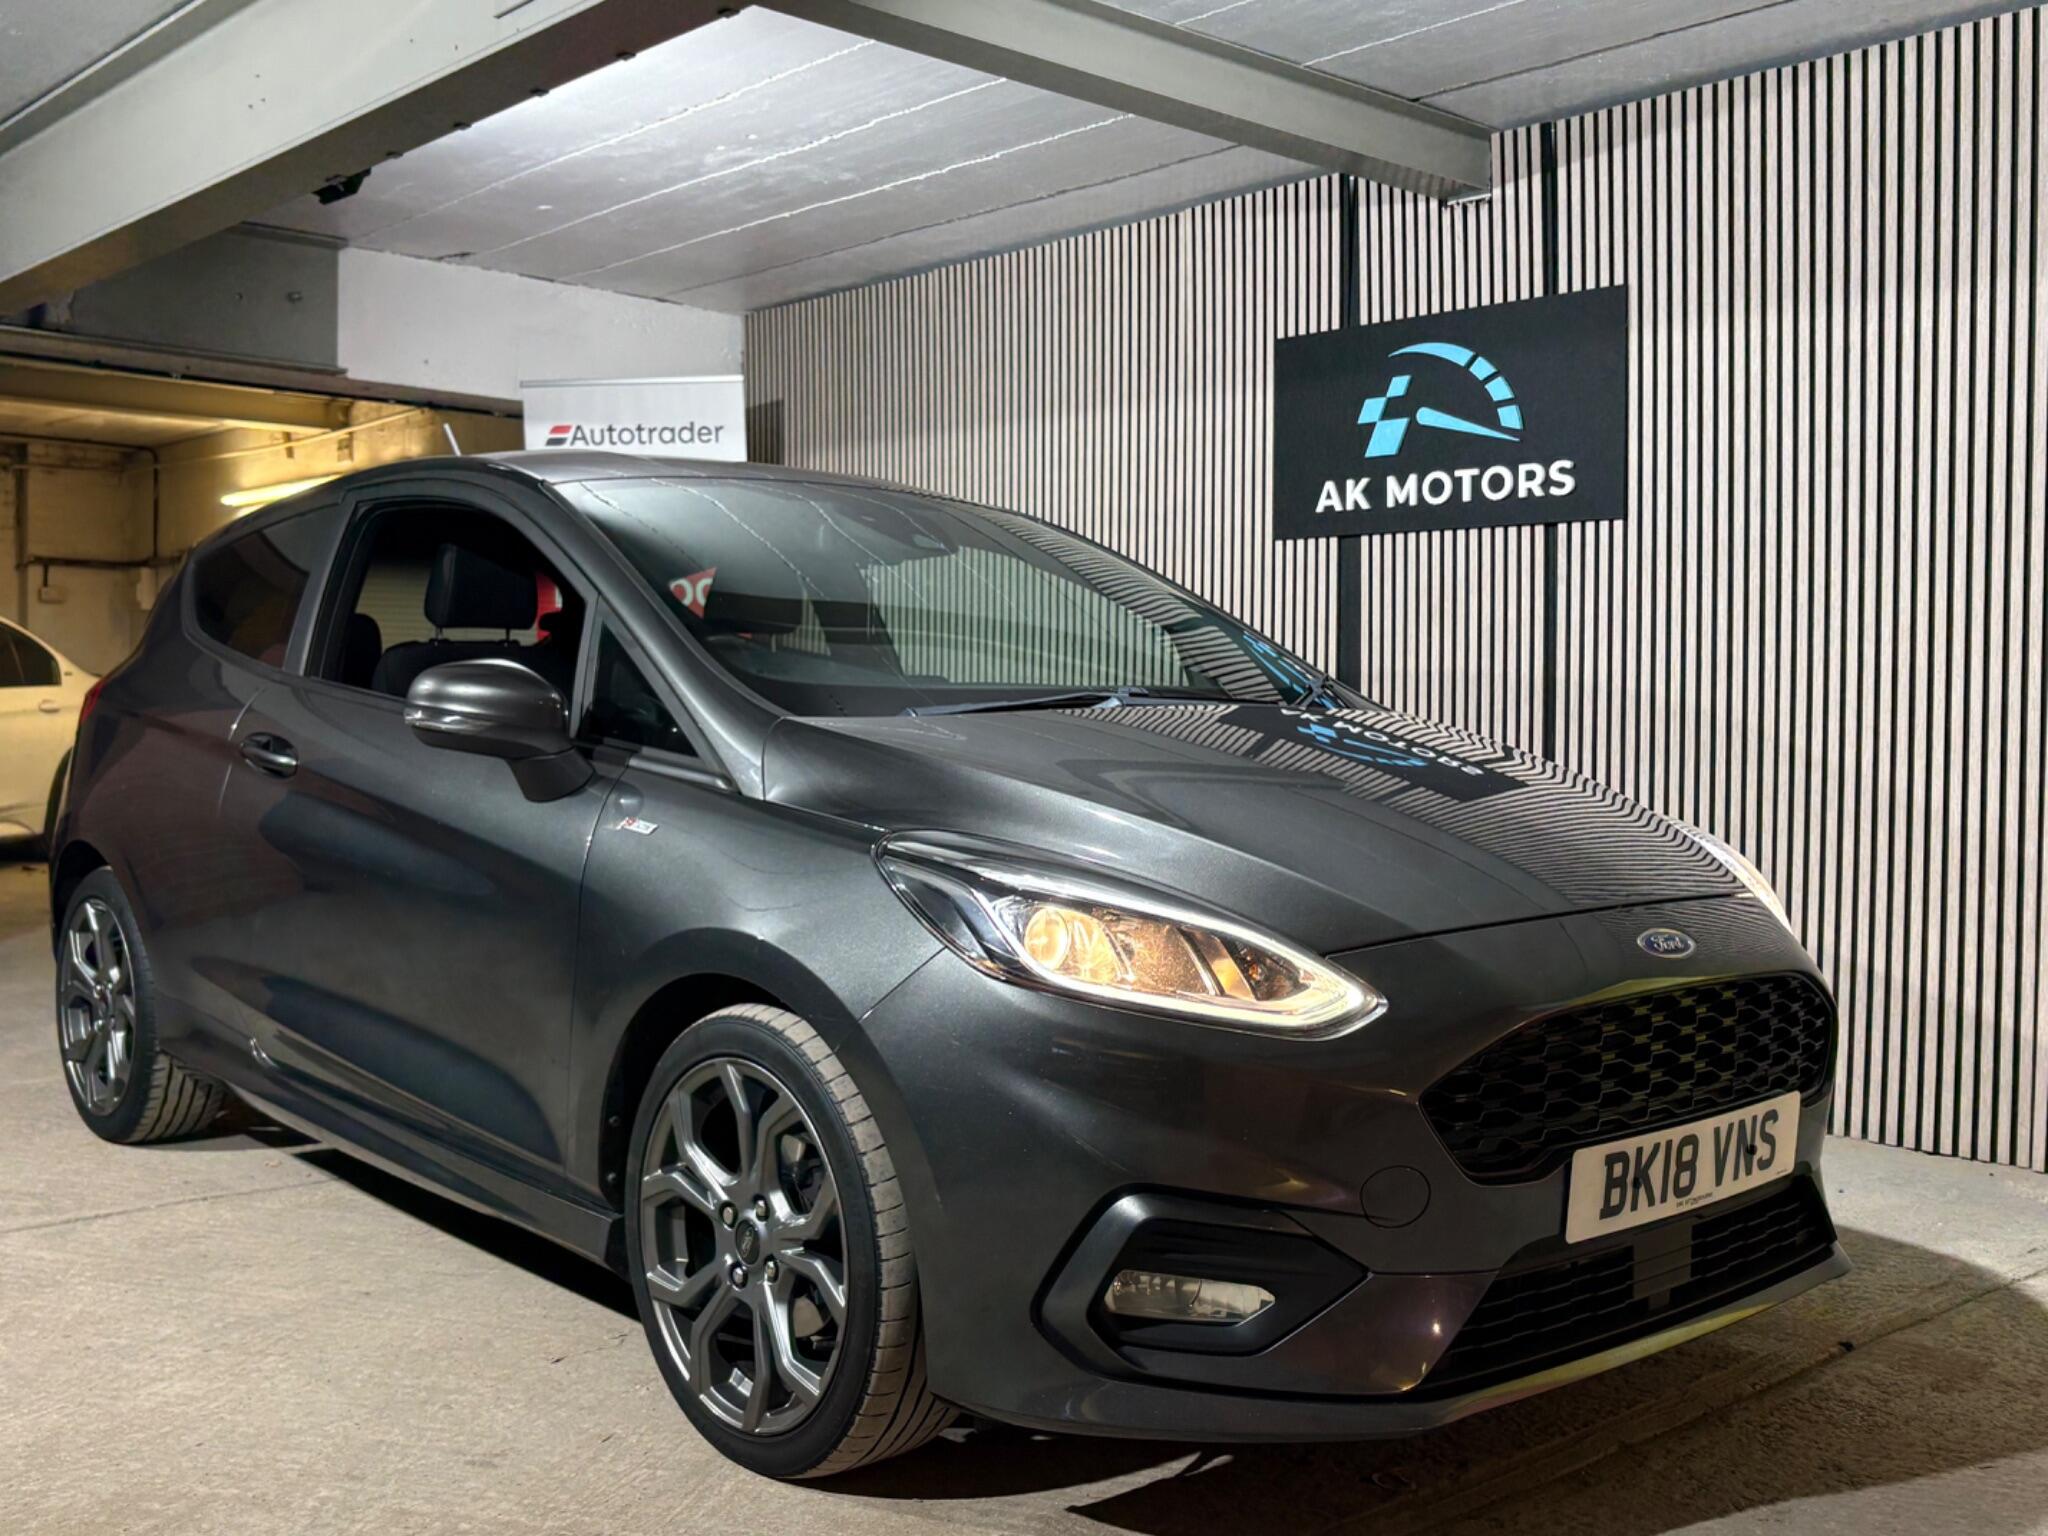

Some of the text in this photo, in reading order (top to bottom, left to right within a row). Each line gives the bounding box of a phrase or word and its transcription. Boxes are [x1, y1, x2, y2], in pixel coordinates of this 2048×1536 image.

[570, 421, 724, 446] Autotrader
[1315, 459, 1577, 513] AK MOTORS
[1599, 1108, 1779, 1221] BK18 VNS
